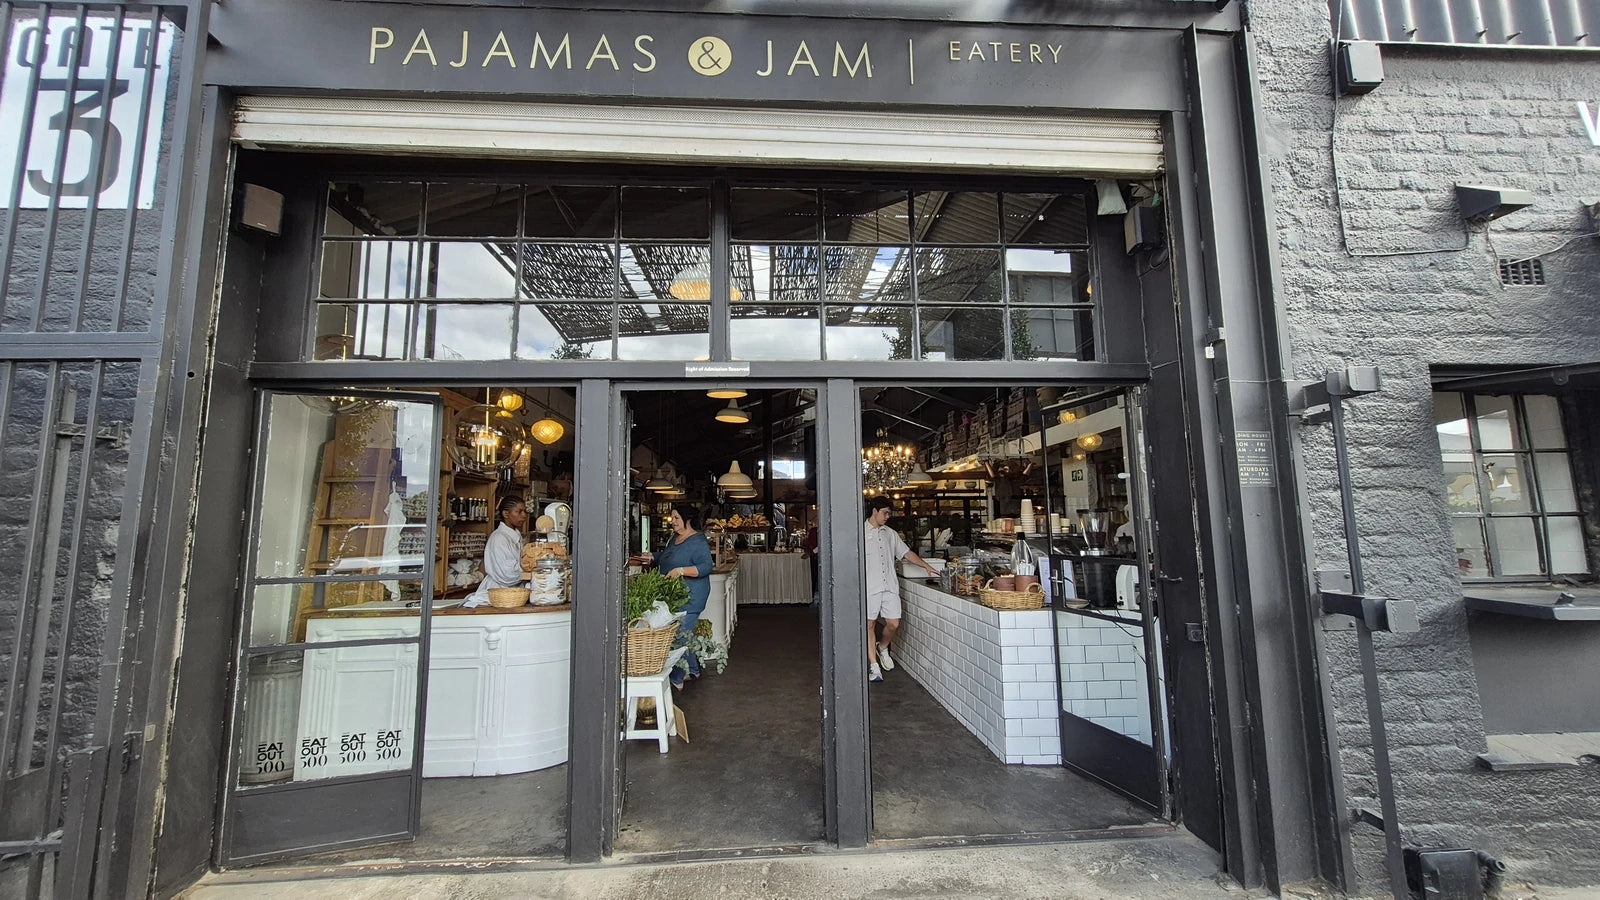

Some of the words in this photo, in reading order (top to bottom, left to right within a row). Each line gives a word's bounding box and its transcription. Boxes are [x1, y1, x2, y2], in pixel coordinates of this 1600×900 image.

[16, 25, 167, 69] GATE
[369, 26, 658, 73] PAJAMAS
[694, 39, 725, 71] &
[755, 39, 874, 79] JAM
[948, 40, 1064, 65] EATERY
[27, 78, 130, 198] 3
[341, 732, 367, 744] EAT
[376, 729, 402, 740] EAT
[257, 742, 284, 753] EAT
[302, 737, 328, 748] EAT
[340, 741, 366, 752] OUT
[376, 738, 401, 748] OUT
[257, 750, 284, 761] OUT
[301, 746, 327, 756] OUT
[339, 750, 367, 764] 500
[375, 747, 402, 760] 500
[256, 760, 285, 774] 500
[300, 755, 328, 768] 500
